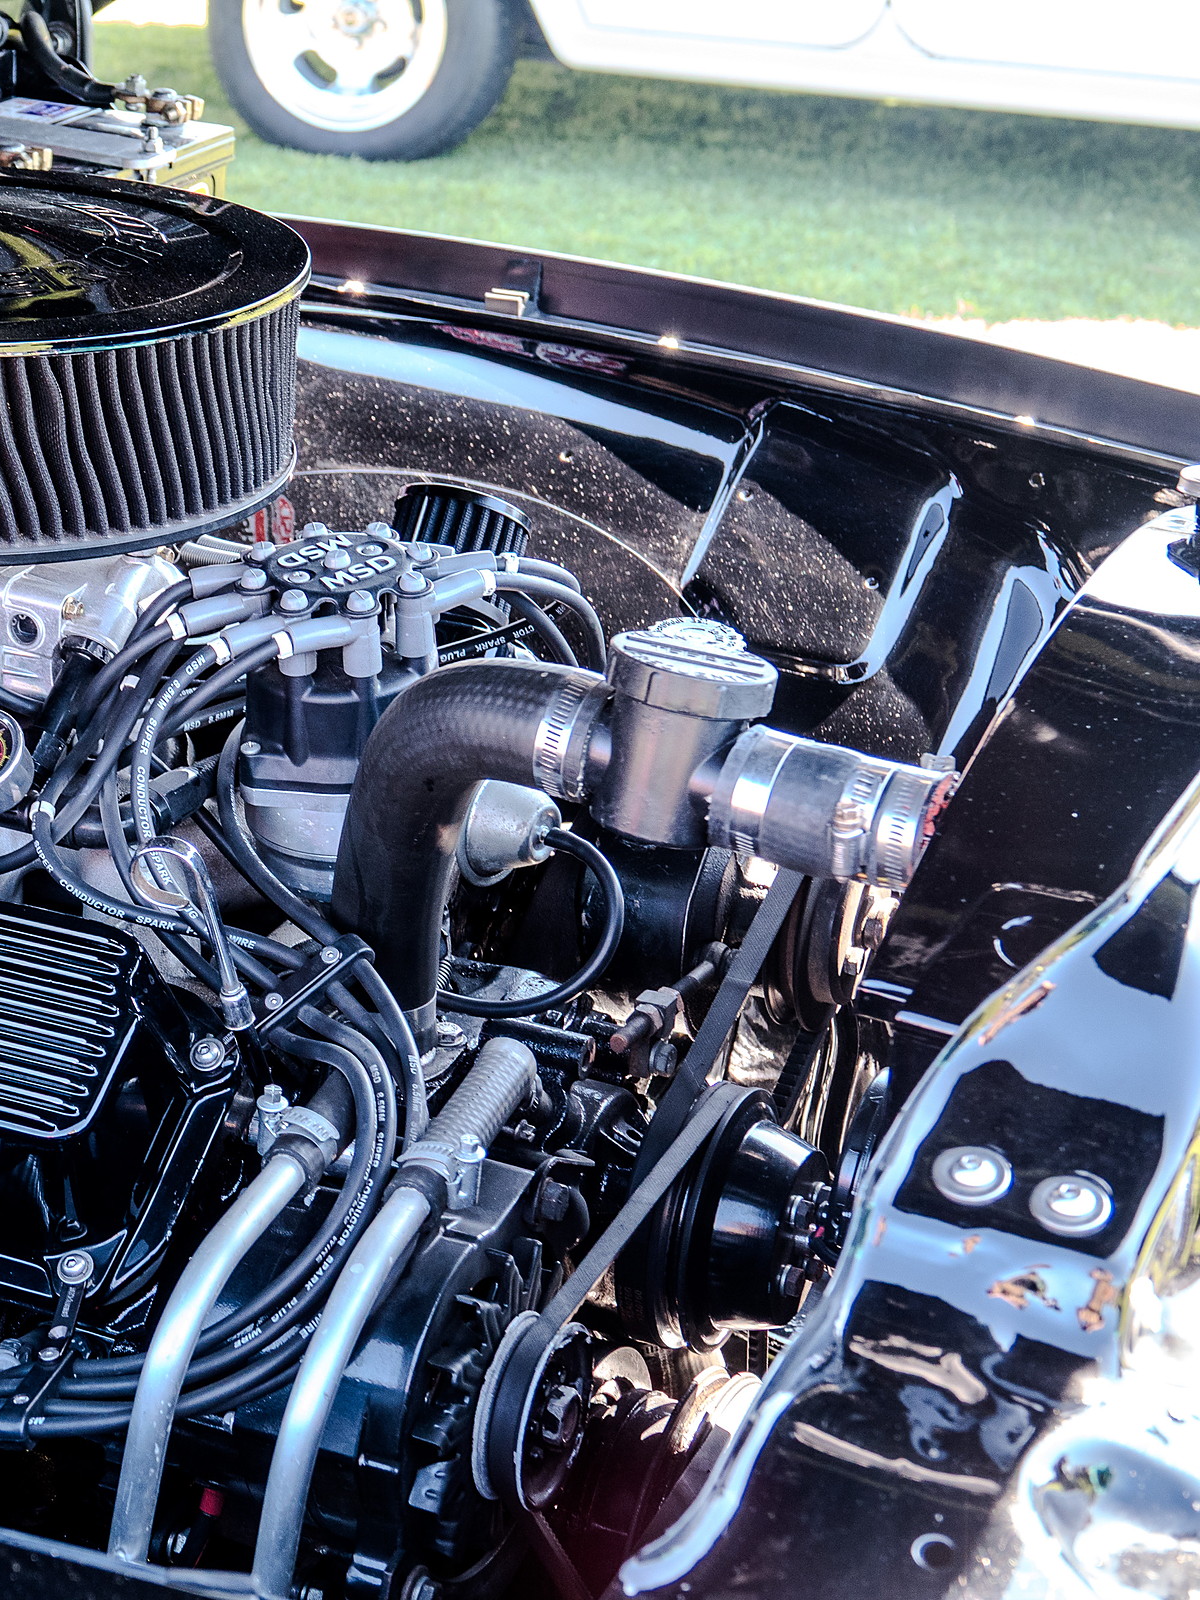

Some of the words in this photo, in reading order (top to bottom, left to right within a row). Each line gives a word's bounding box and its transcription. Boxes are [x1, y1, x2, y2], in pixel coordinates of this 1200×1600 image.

[277, 534, 354, 568] MSD
[320, 555, 398, 592] MSD
[440, 648, 466, 663] PLUG
[474, 636, 506, 652] SPARK
[186, 654, 206, 676] MSD
[139, 717, 158, 756] SUPER
[184, 720, 201, 732] MSD
[208, 710, 234, 724] 8.5MM
[136, 766, 152, 839] CONDUCTOR
[150, 851, 173, 886] SPARK
[33, 840, 54, 873] SUPER
[59, 878, 126, 920] CONDUCTOR
[135, 915, 176, 932] SPARK
[228, 934, 256, 950] WIRE
[368, 1064, 382, 1084] MSD
[371, 1132, 385, 1168] SUPER
[337, 1178, 374, 1247] CONDUCTOR
[304, 1254, 334, 1292] SPARK
[270, 1296, 298, 1324] PLUG
[233, 1326, 262, 1349] WIRE
